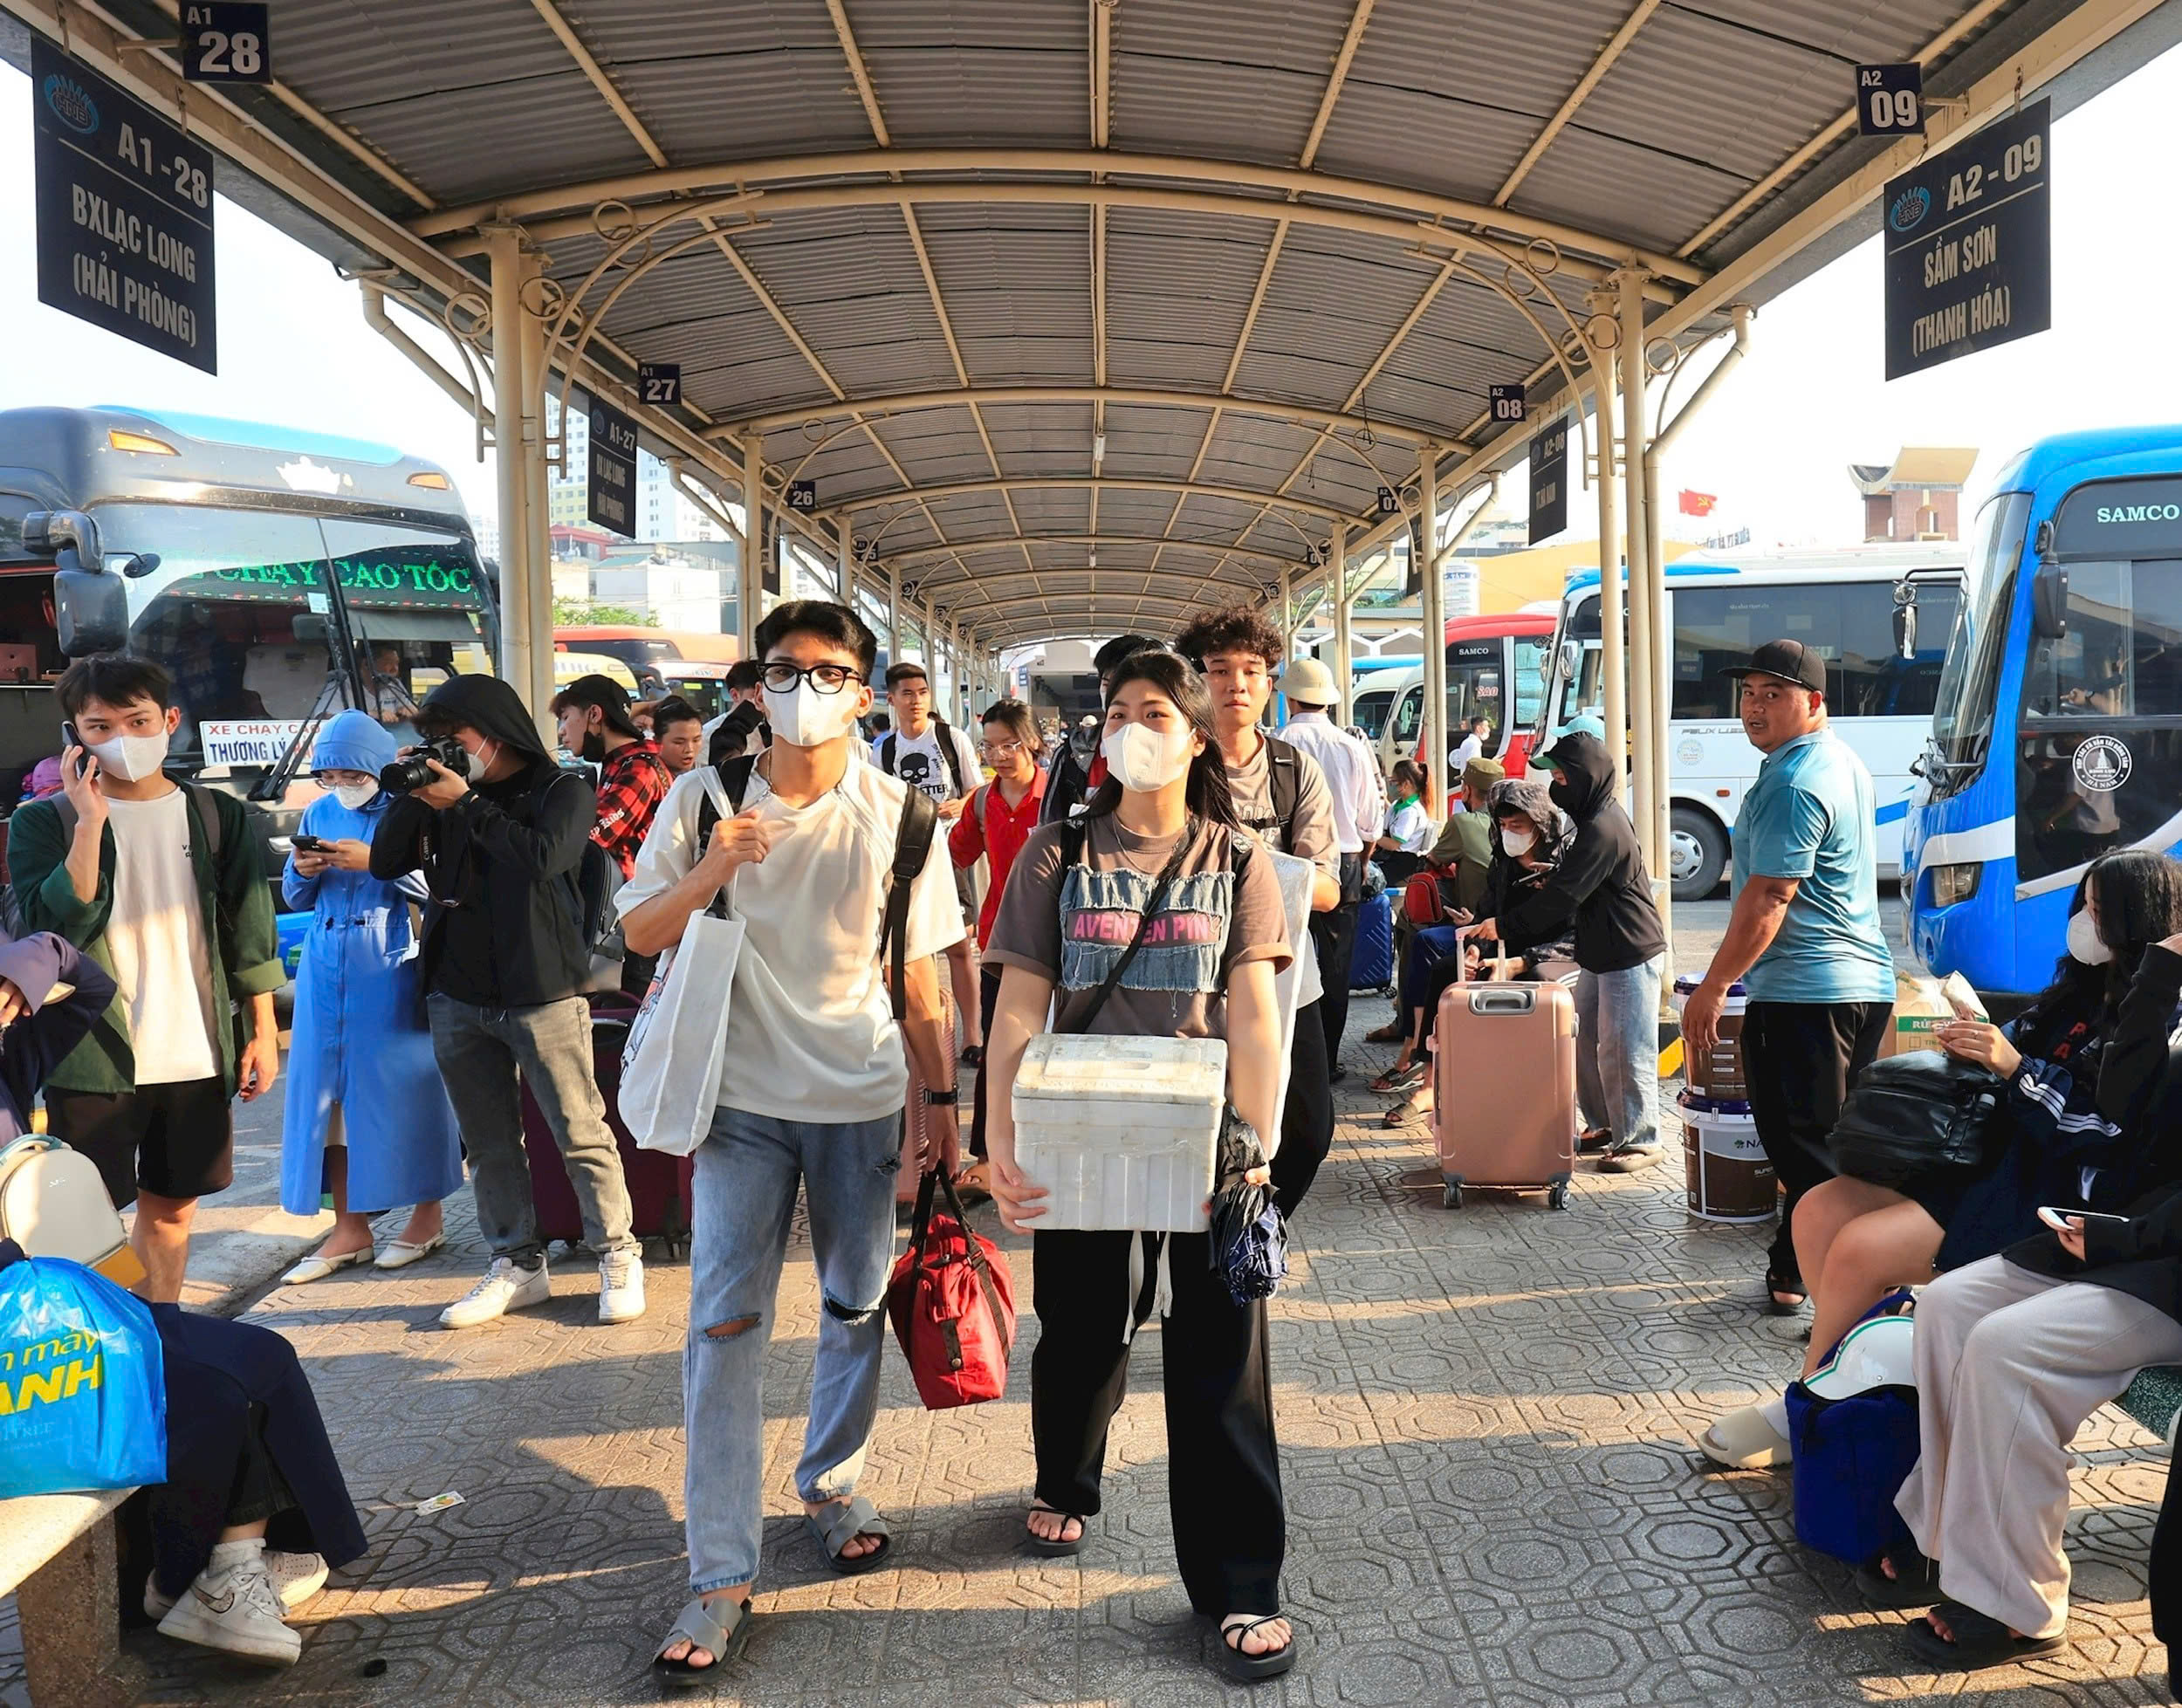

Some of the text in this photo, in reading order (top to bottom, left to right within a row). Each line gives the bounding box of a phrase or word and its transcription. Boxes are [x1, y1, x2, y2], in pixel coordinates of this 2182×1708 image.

[187, 7, 212, 25] A1
[198, 31, 262, 75] 28
[1861, 70, 1883, 87] A2
[1870, 89, 1918, 129] 09
[148, 223, 196, 284] LONG
[1924, 223, 1997, 289] SẦM SƠN
[73, 250, 197, 348] (HẢI PHÒNG)
[1912, 282, 2011, 358] (THANH HÓA)
[641, 367, 654, 377] A1
[646, 379, 676, 401] 27
[1492, 388, 1504, 397] A2
[1496, 399, 1522, 419] 08
[793, 490, 813, 505] 26
[2096, 504, 2180, 523] SAMCO
[209, 724, 231, 735] XE
[209, 741, 268, 763] THƯƠNG
